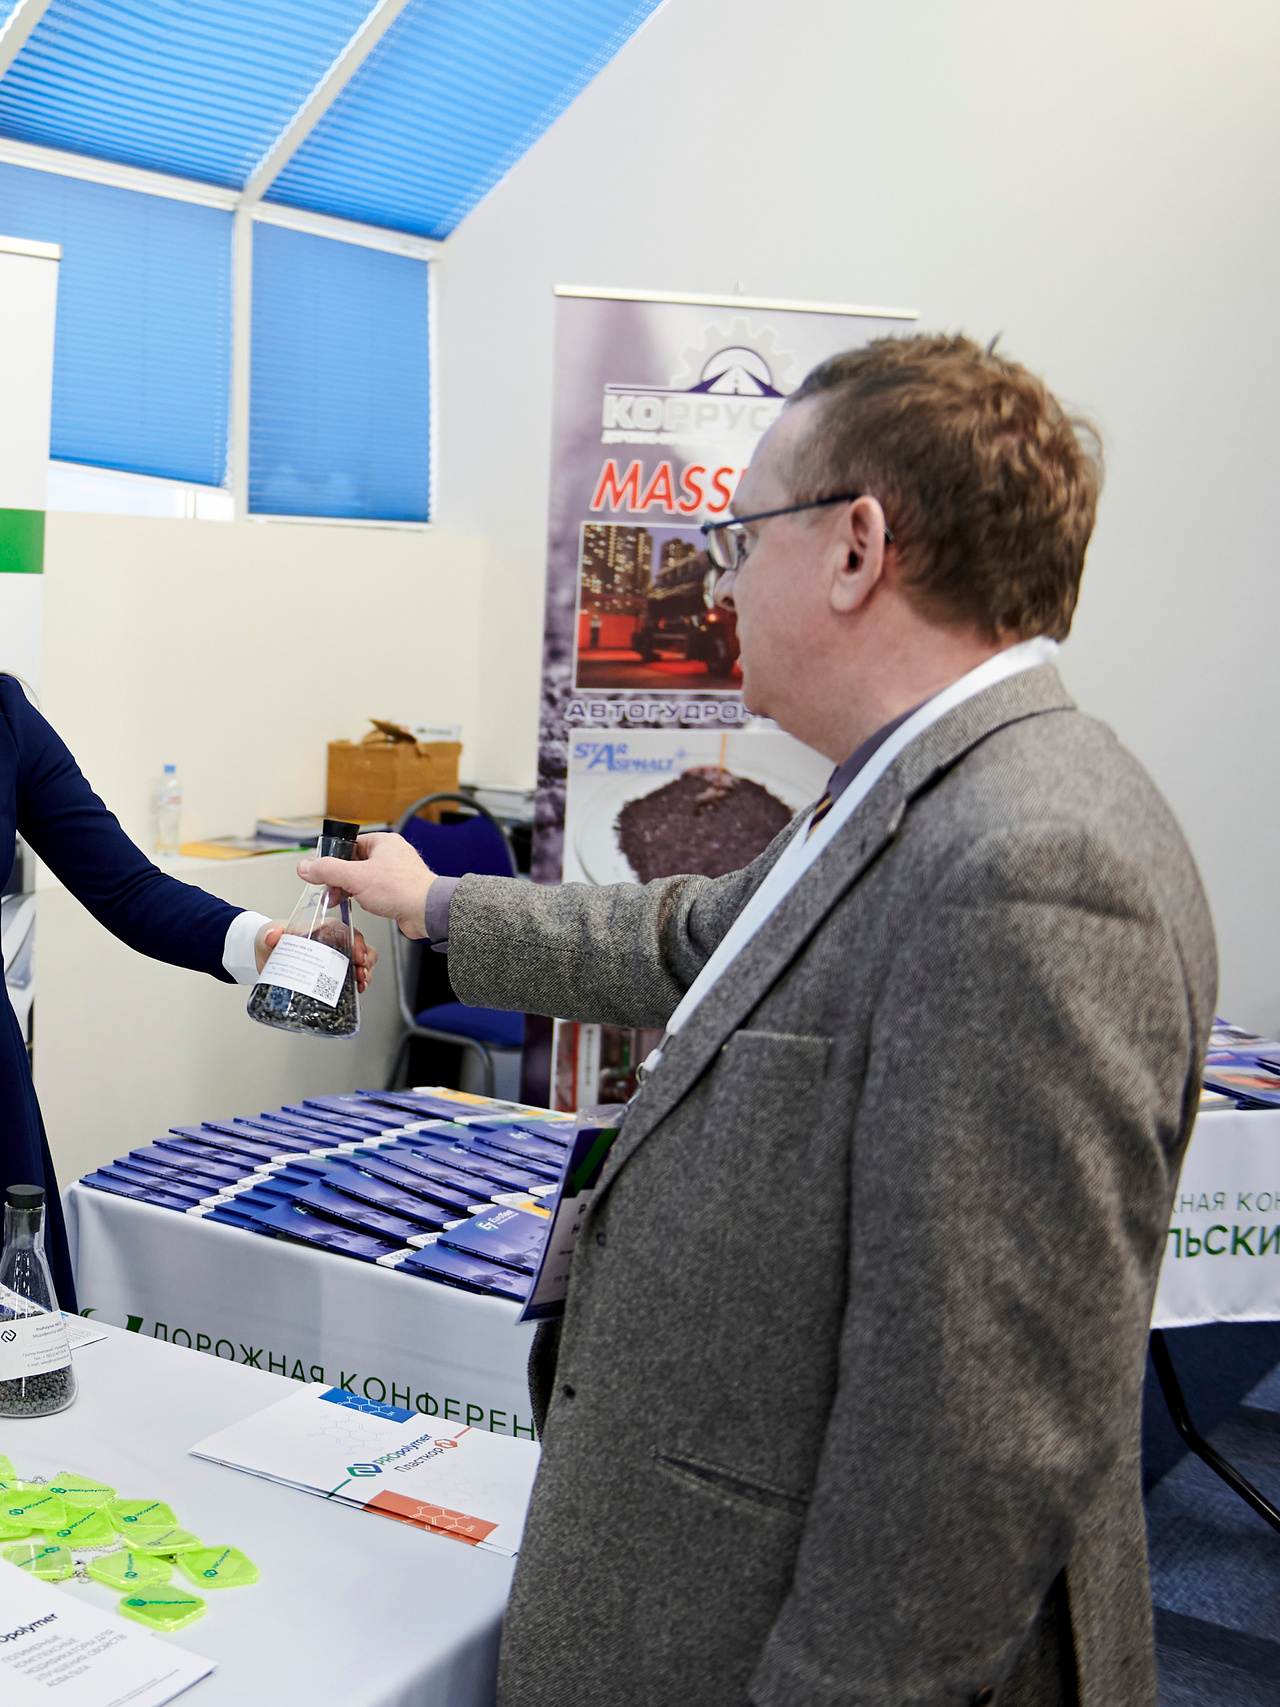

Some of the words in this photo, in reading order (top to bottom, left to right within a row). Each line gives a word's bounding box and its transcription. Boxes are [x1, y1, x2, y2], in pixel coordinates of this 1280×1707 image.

[590, 458, 748, 514] MASS
[1171, 1192, 1226, 1213] НАЯ
[154, 1321, 325, 1383] ДОРОЖНАЯ
[372, 1432, 433, 1466] PROpolymer
[393, 1446, 444, 1473] Пласткор
